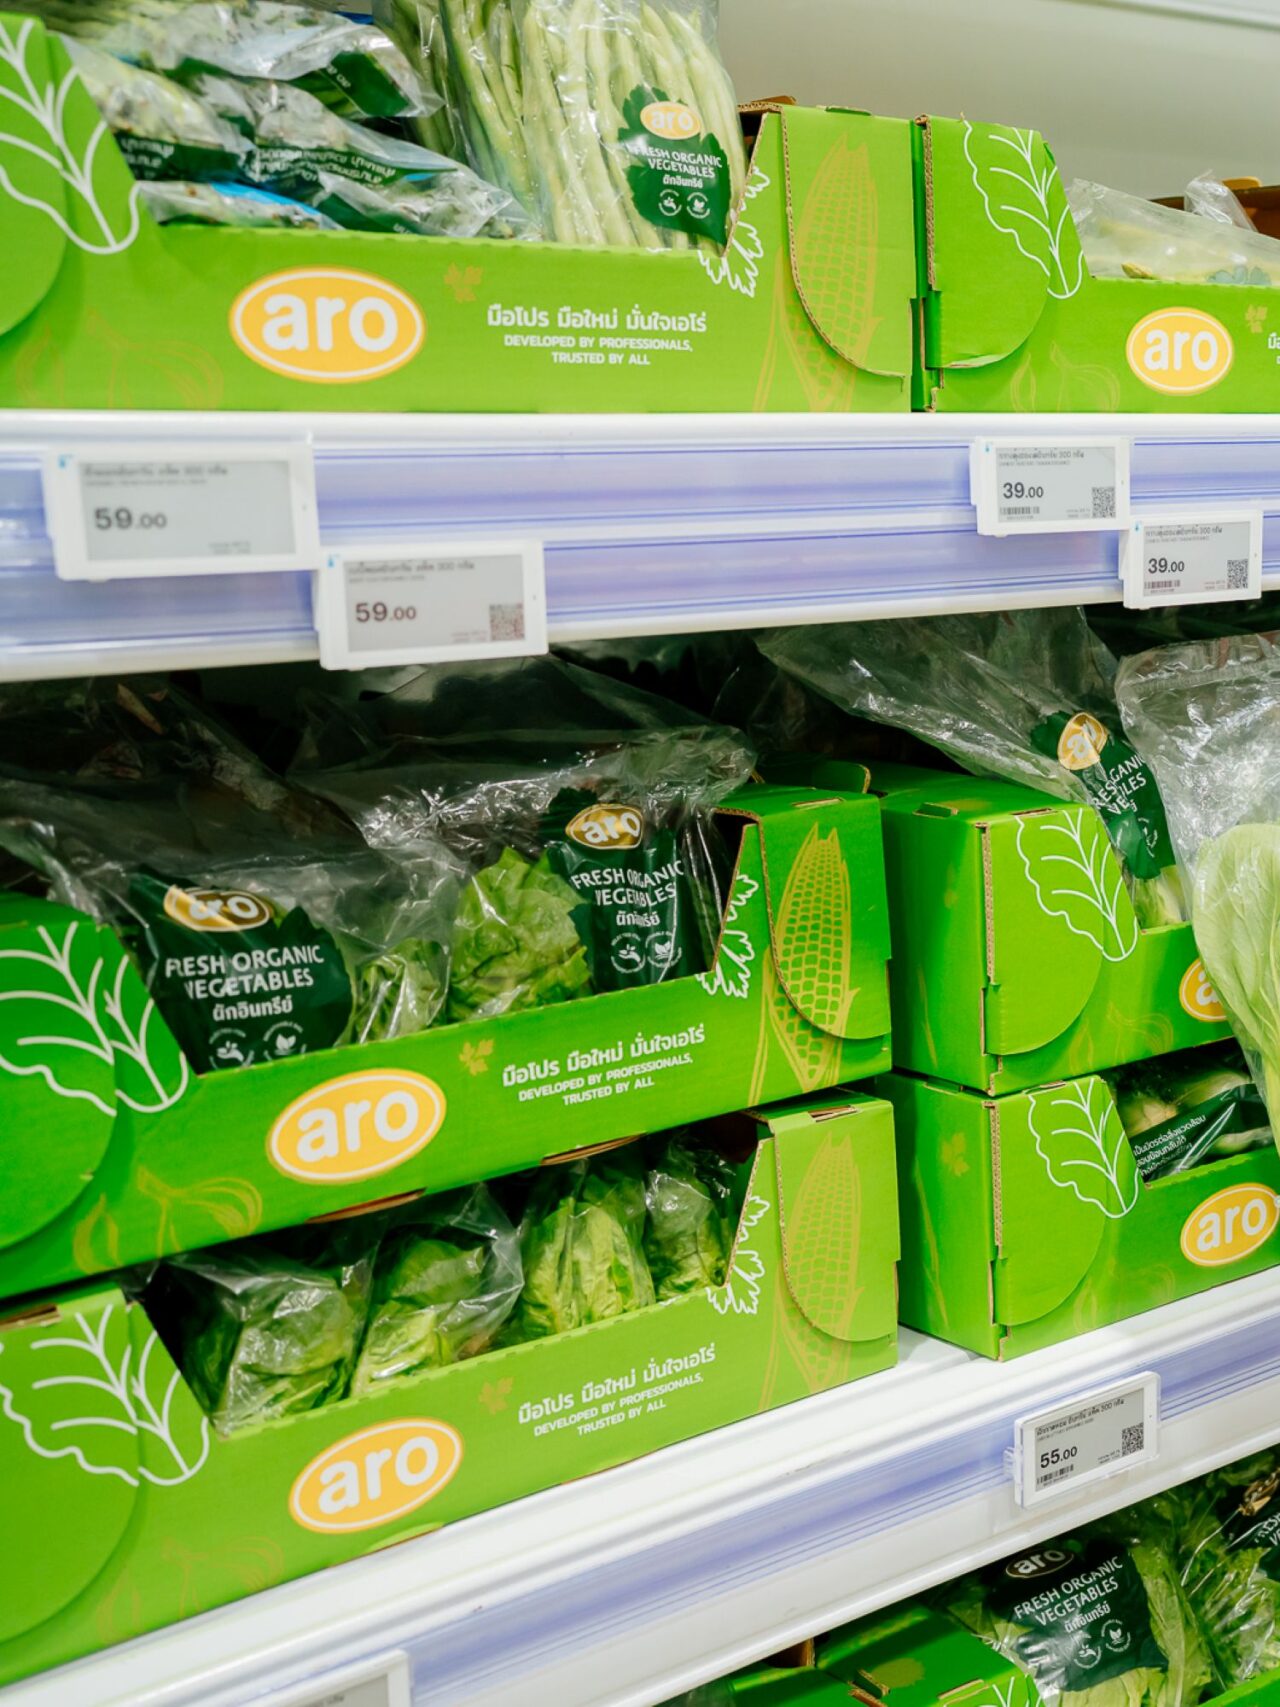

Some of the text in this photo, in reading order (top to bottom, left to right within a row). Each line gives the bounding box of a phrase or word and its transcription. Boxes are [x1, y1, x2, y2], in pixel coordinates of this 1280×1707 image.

[651, 110, 694, 131] aro
[648, 158, 715, 179] VEGETABLES
[671, 151, 723, 168] ORGANIC
[262, 294, 398, 352] aro
[487, 303, 549, 327] มือโปร
[557, 305, 618, 330] มือใหม่
[504, 334, 693, 352] DEVELOPED BY PROFESSIONALS,
[552, 351, 651, 365] TRUSTED BY ALL
[1143, 328, 1218, 371] aro
[1003, 482, 1044, 498] 39.00
[95, 507, 167, 530] 59.00
[1148, 557, 1185, 574] 39.00
[355, 602, 417, 622] 59.00
[582, 812, 640, 844] aro
[571, 867, 625, 889] FRESH
[165, 945, 324, 978] FRESH ORGANIC
[184, 968, 313, 1000] VEGETABLES
[502, 1059, 560, 1087] มือโปร
[567, 1041, 623, 1072] มือใหม่
[518, 1053, 693, 1102] DEVELOPED BY PROFESSIONALS,
[563, 1076, 655, 1105] TRUSTED BY ALL
[296, 1090, 419, 1163] aro
[1196, 1198, 1267, 1252] aro
[518, 1392, 574, 1424] มือโปร
[581, 1369, 636, 1403] มือใหม่
[533, 1372, 704, 1437] DEVELOPED BY PROFESSIONALS,
[577, 1399, 667, 1436] TRUSTED BY ALL
[1040, 1446, 1078, 1469] 55.00
[317, 1436, 439, 1515] aro
[1014, 1550, 1066, 1575] aro
[1014, 1556, 1124, 1620] FRESH ORGANIC
[1035, 1576, 1119, 1627] VEGETABLES
